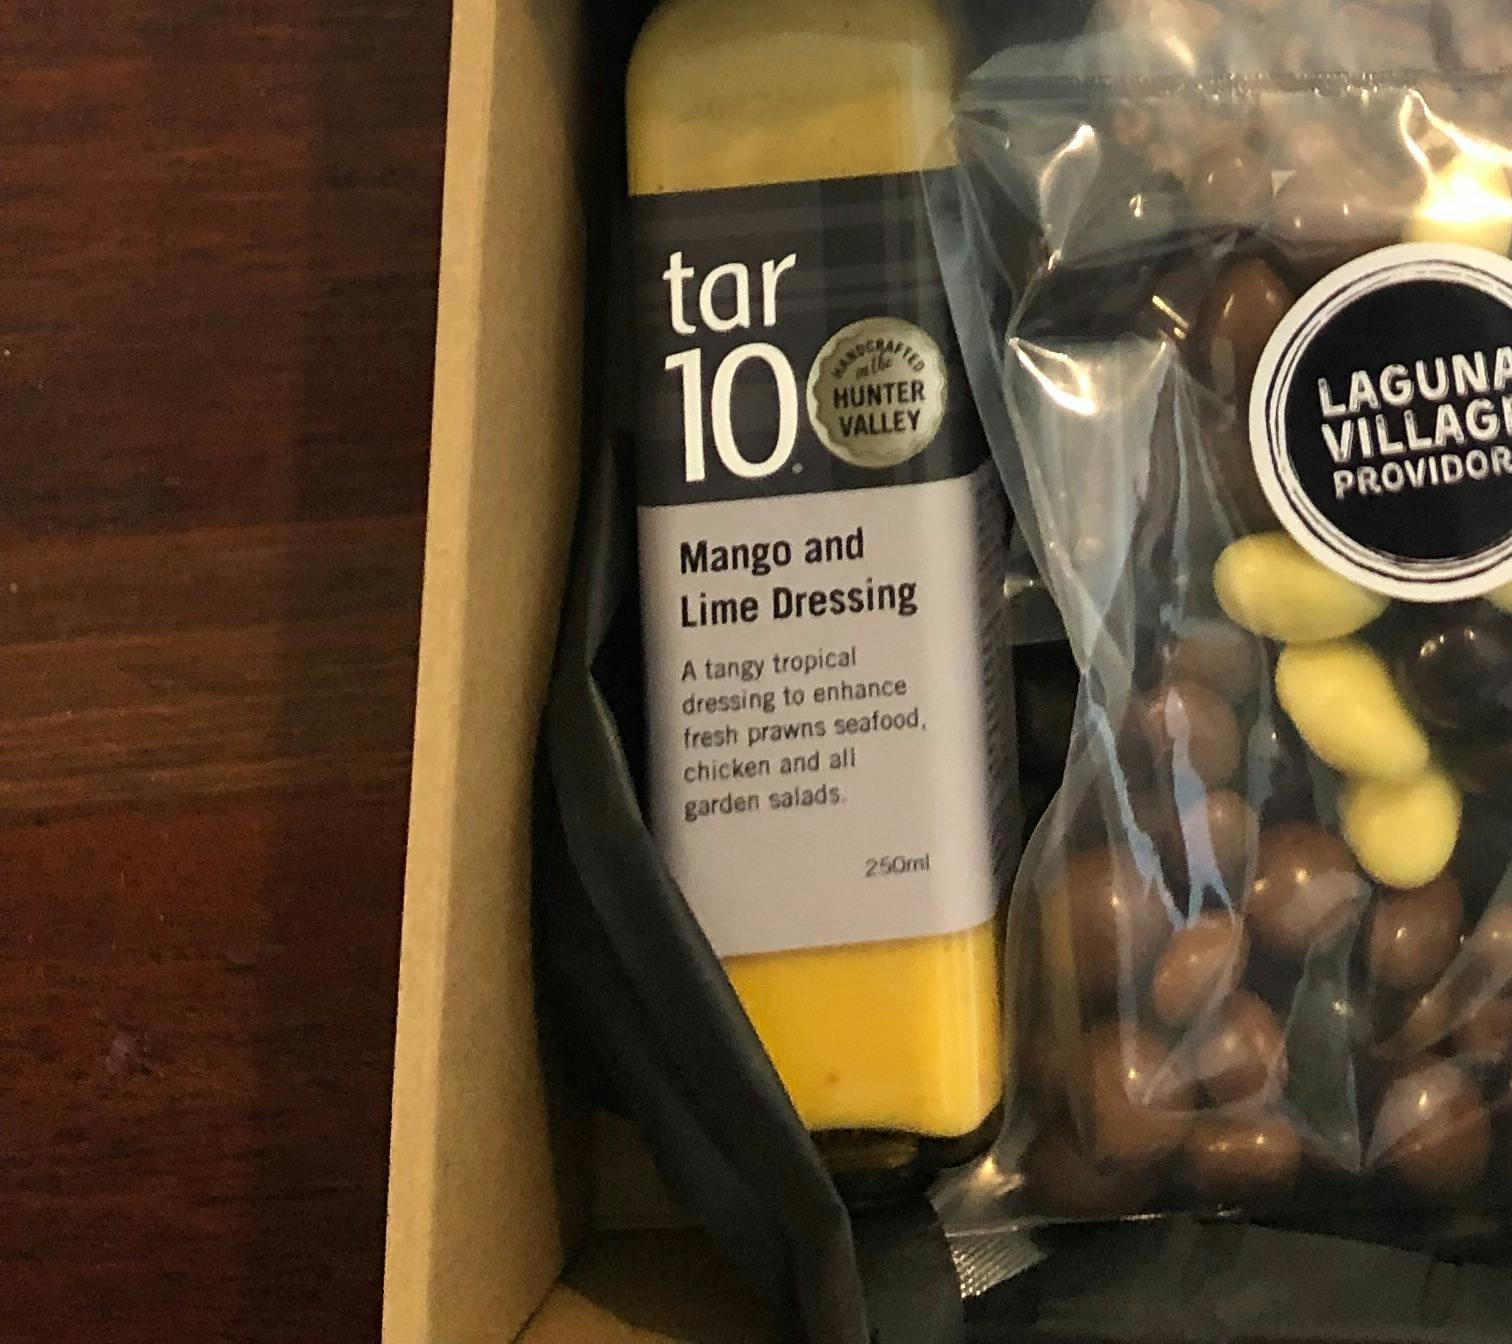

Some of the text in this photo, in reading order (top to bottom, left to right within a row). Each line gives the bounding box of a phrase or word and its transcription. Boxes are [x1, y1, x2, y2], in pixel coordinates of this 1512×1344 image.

[661, 250, 798, 336] tar
[664, 341, 799, 483] 10
[832, 378, 927, 410] HUNTER
[838, 408, 921, 438] VALLEY
[679, 525, 865, 577] Mango and
[680, 576, 919, 628] Lime Dressing
[681, 644, 858, 683] A tangy tropical
[681, 676, 908, 716] dressing to enhance
[683, 723, 738, 750] fresh
[747, 717, 827, 748] prawns
[683, 746, 857, 785] chicken and all
[683, 793, 761, 824] garden
[864, 852, 931, 879] 250ml
